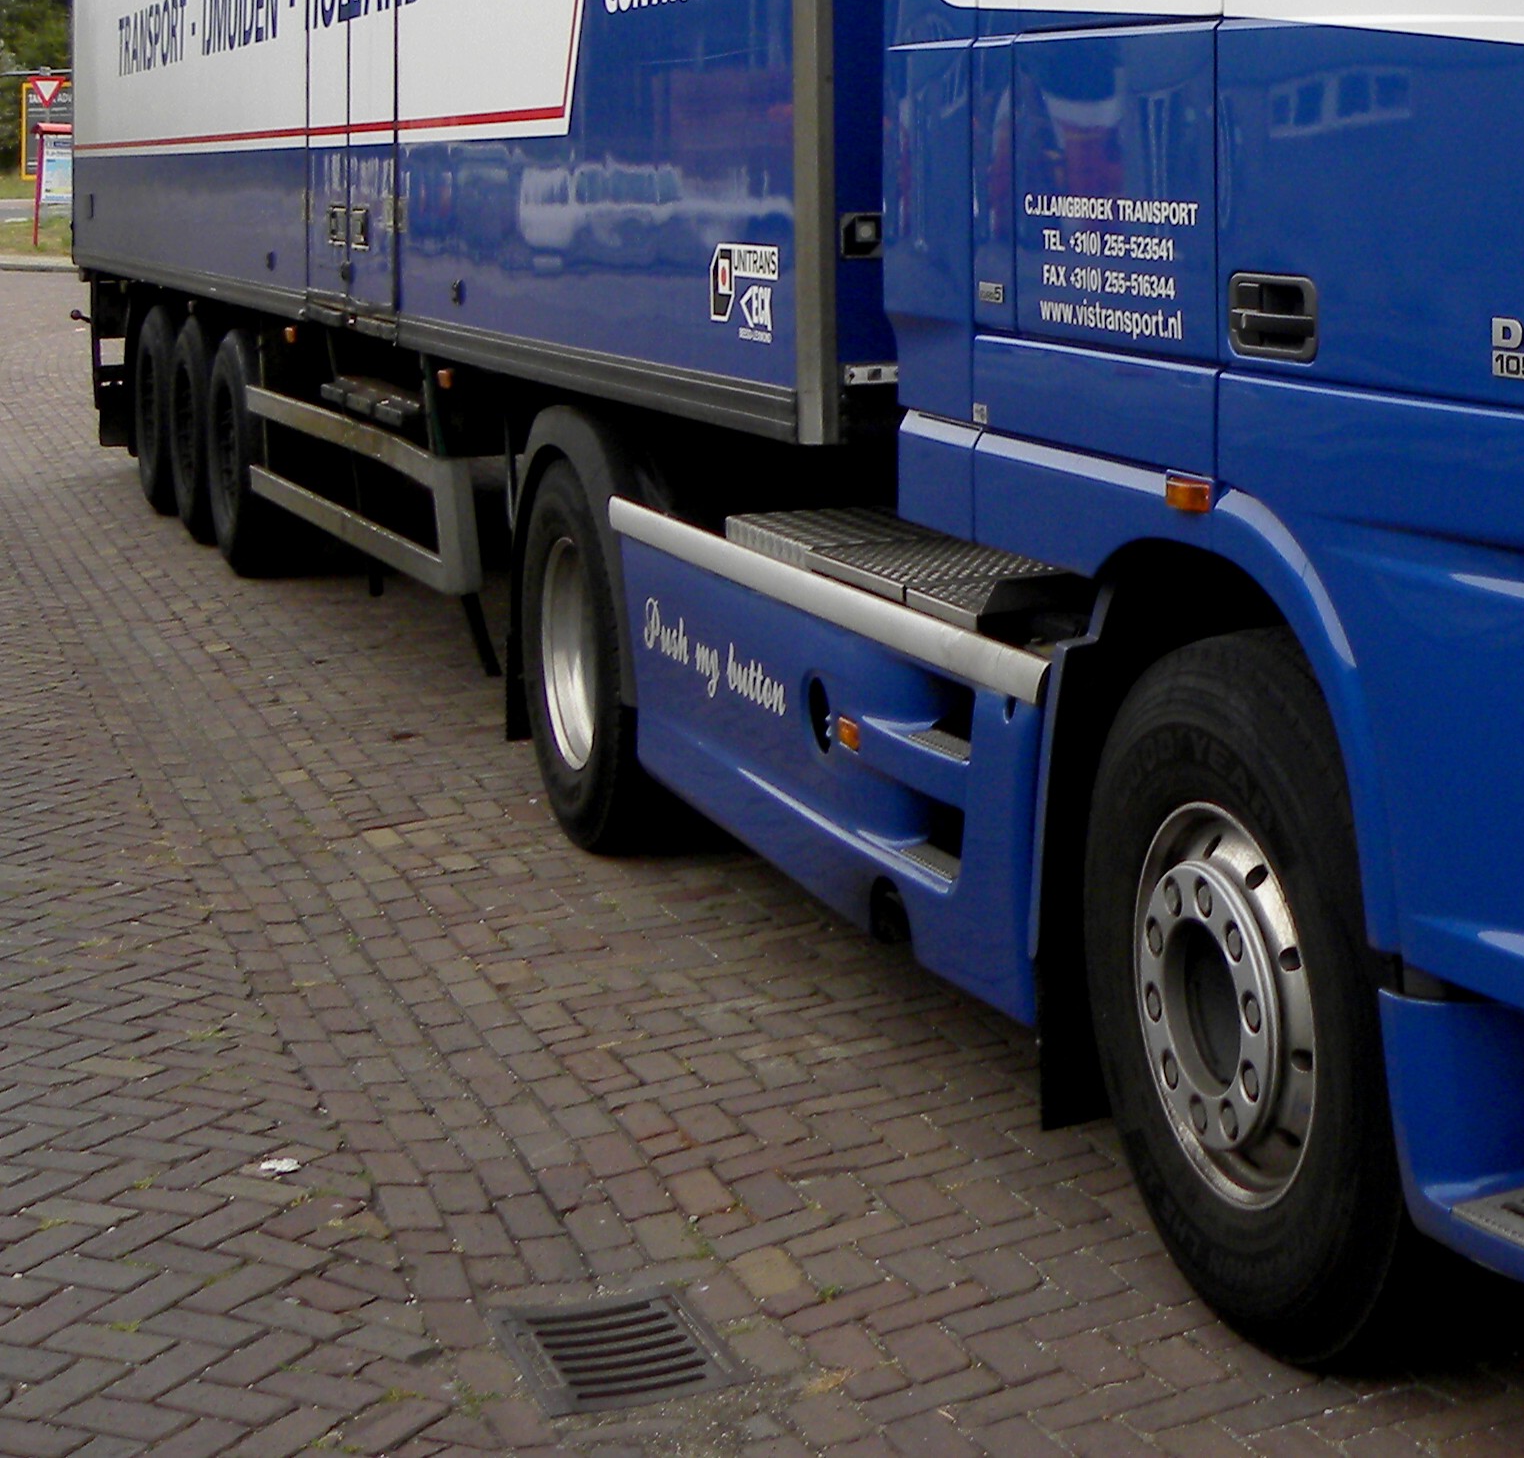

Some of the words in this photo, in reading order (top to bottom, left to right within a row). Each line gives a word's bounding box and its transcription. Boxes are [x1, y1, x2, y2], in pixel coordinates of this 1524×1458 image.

[1025, 194, 1113, 221] C.J.LANGBROEK
[1117, 199, 1198, 226] TRANSPORT
[734, 249, 776, 275] UNITRANS
[1069, 230, 1101, 257] +31(0)
[1104, 233, 1174, 261] 255-523541
[1042, 264, 1066, 287] FAX
[1070, 266, 1101, 293] +31(0)
[1104, 270, 1176, 300] 255-516344
[1040, 298, 1183, 340] www.vistransport.nl
[644, 597, 689, 665] Push
[695, 642, 720, 698] my
[727, 642, 786, 717] button
